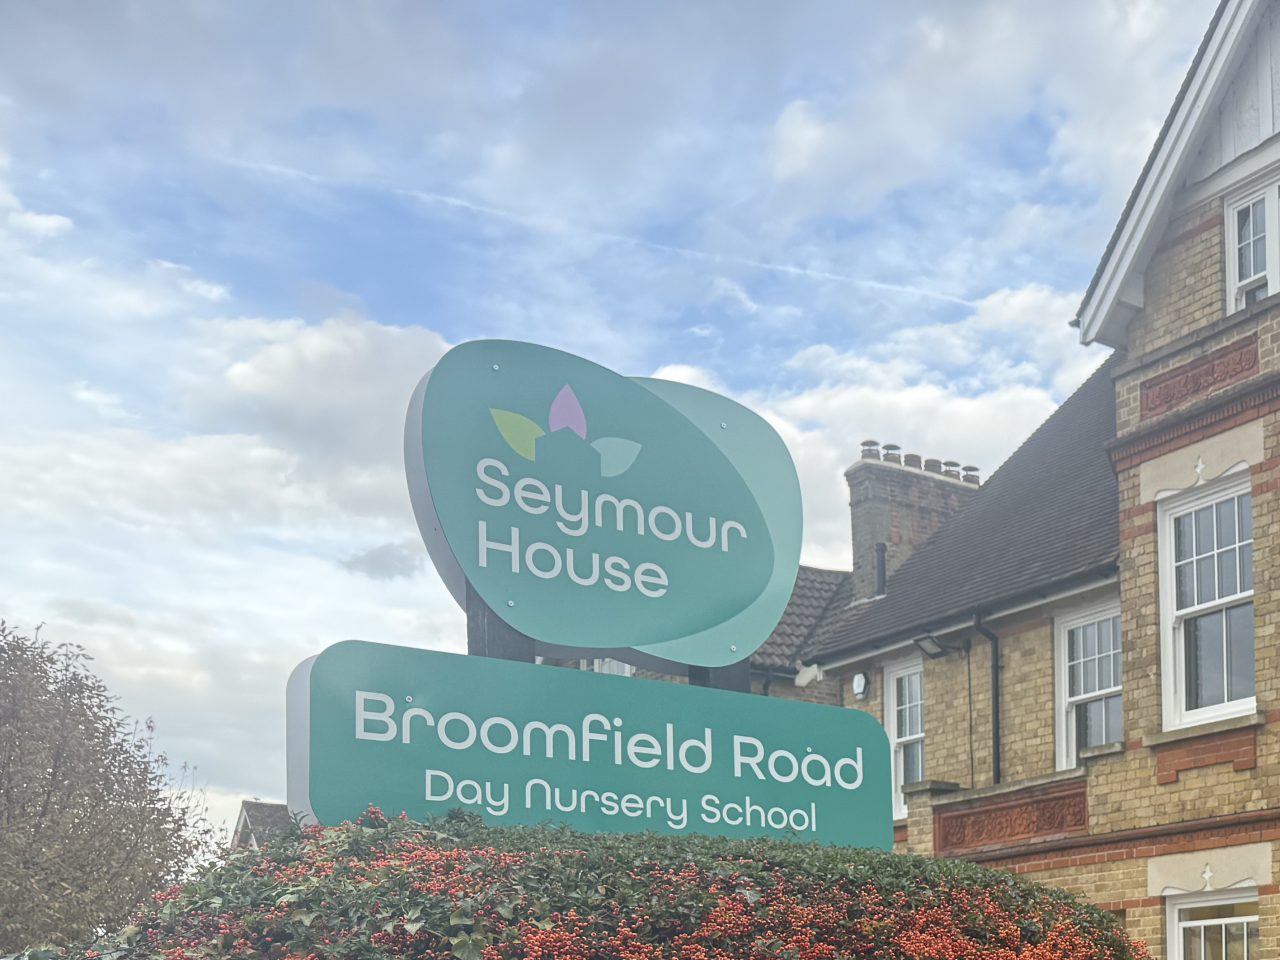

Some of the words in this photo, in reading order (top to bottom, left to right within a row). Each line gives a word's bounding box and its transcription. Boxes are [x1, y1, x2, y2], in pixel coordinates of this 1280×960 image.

[475, 458, 748, 552] Seymour
[477, 521, 670, 598] House
[354, 690, 713, 774] Broomfield
[733, 735, 864, 790] Road
[425, 770, 510, 817] Day
[525, 779, 689, 830] Nursery
[700, 795, 817, 831] School
